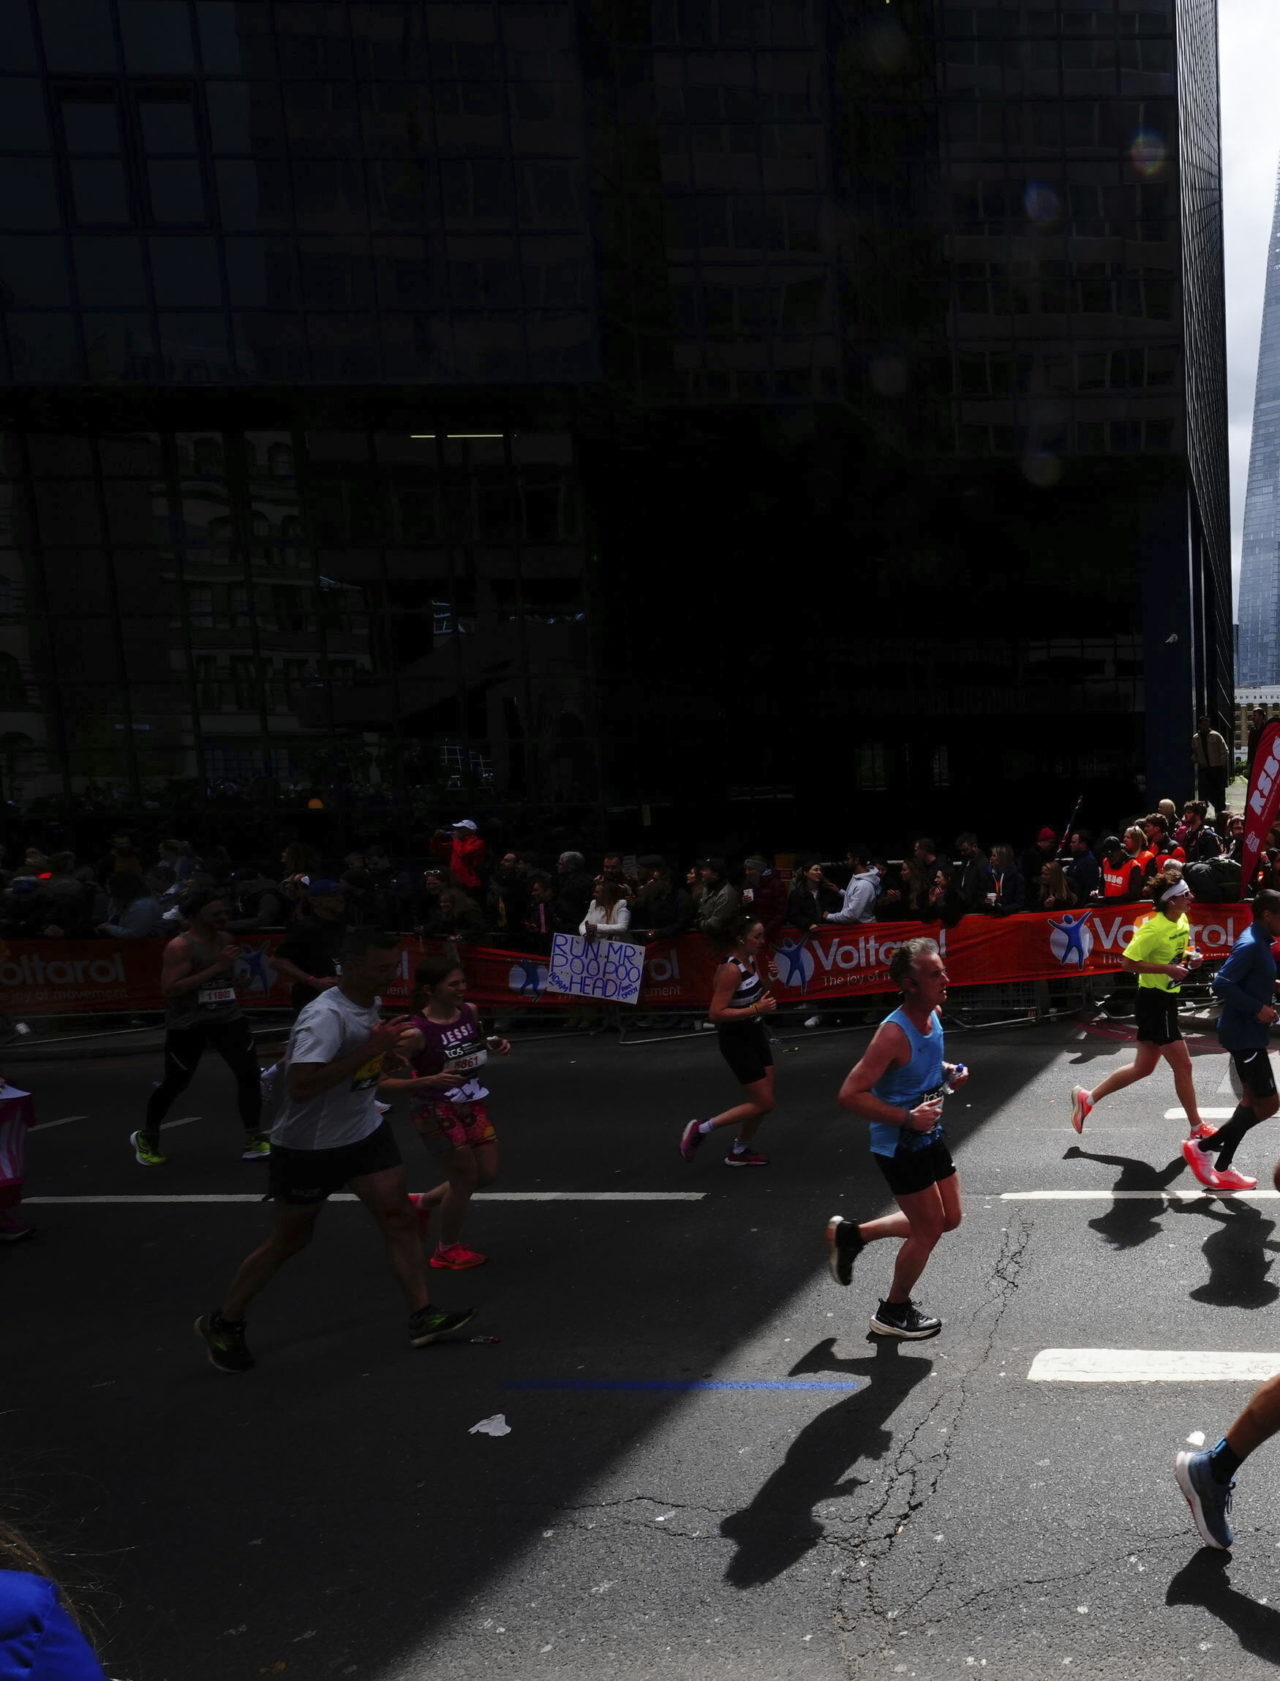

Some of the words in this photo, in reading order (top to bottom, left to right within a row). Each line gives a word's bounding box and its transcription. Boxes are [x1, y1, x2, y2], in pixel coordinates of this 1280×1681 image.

[1092, 916, 1234, 950] Vorol
[553, 934, 600, 960] RUN
[607, 942, 636, 966] MR
[812, 928, 947, 971] Voltal
[0, 952, 128, 985] oltarol
[823, 975, 844, 986] The
[847, 973, 864, 985] joy
[867, 970, 881, 981] of
[569, 975, 622, 1000] HEAD!
[441, 1023, 473, 1045] JESS!
